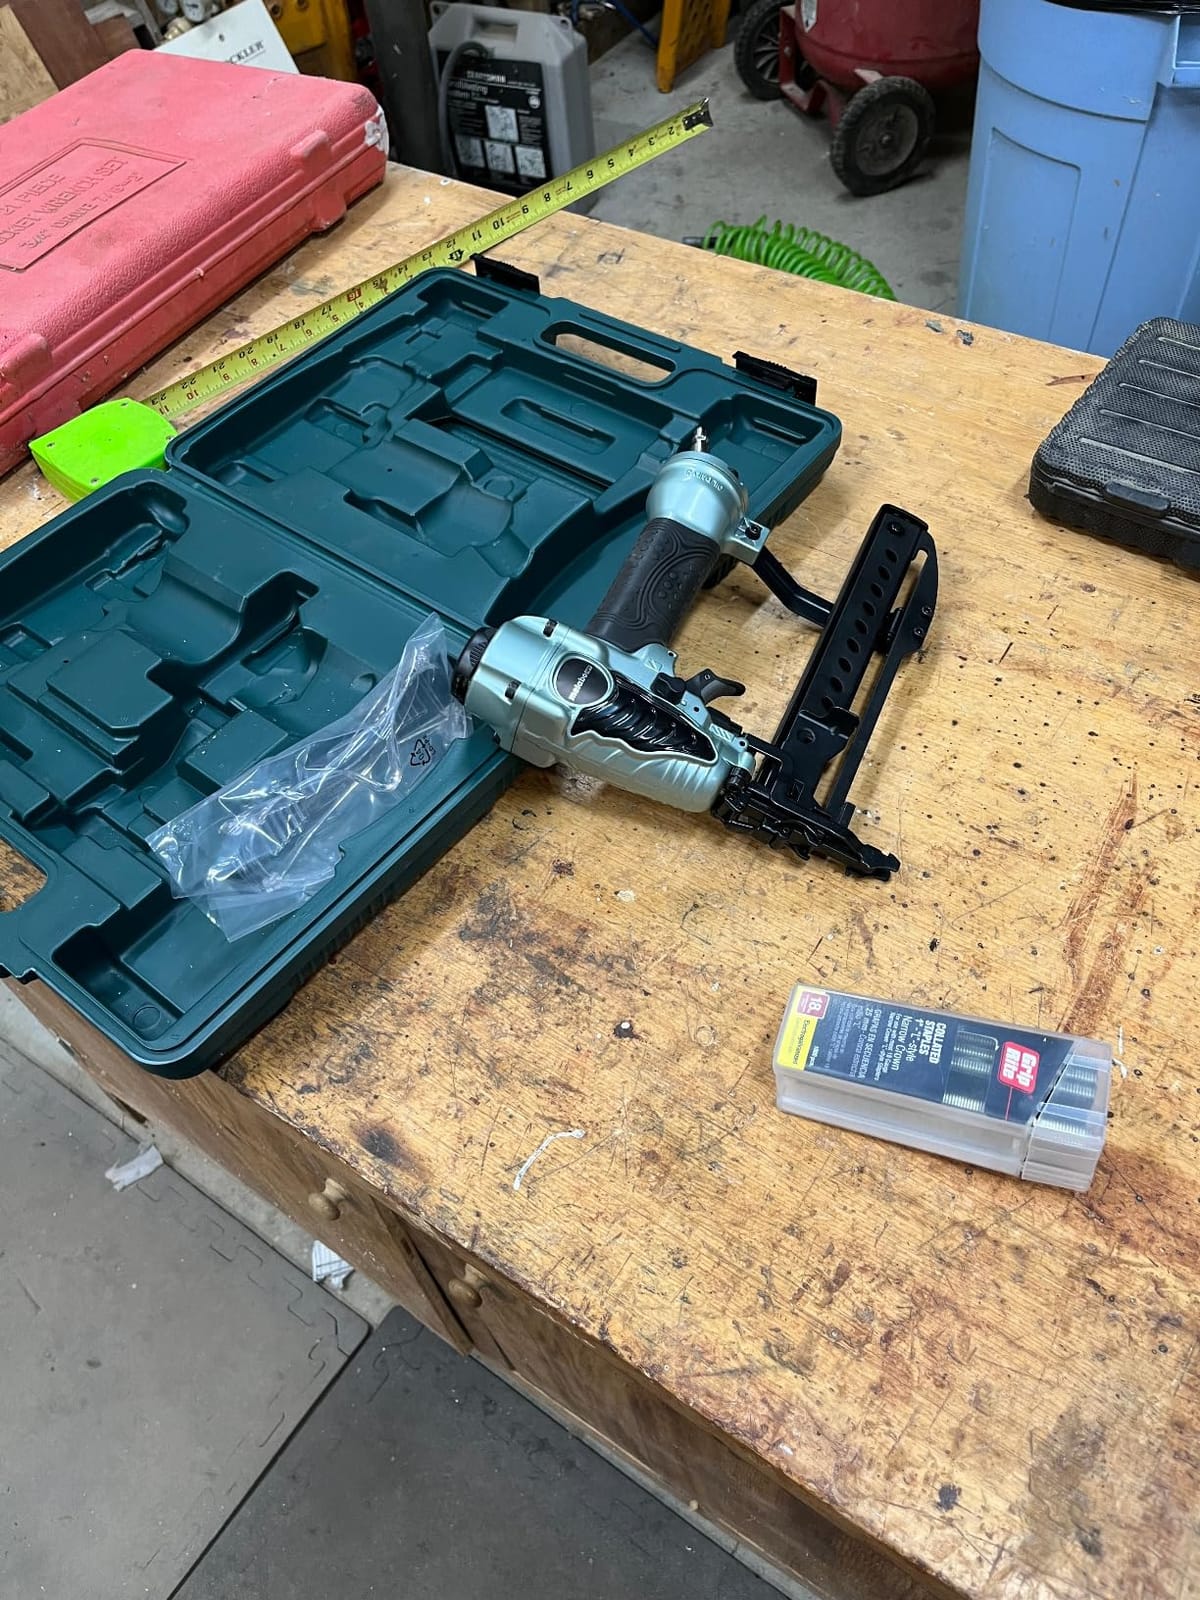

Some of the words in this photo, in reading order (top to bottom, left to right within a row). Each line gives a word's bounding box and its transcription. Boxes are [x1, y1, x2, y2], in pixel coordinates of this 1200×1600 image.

[648, 136, 655, 146] 3
[93, 156, 128, 177] SET
[608, 158, 615, 168] 5
[586, 170, 593, 179] 6
[566, 181, 573, 191] 7
[544, 192, 551, 202] 8
[522, 204, 529, 214] 9
[492, 217, 505, 230] 10
[471, 230, 482, 241] 11
[446, 238, 456, 248] 12
[422, 251, 433, 261] 13
[398, 264, 408, 274] 14
[348, 289, 361, 301] 16
[321, 305, 332, 316] 17
[332, 314, 339, 322] 5
[294, 320, 306, 330] 18
[305, 328, 313, 337] 6
[266, 333, 279, 344] 19
[238, 346, 254, 359] 20
[279, 343, 287, 351] 7
[212, 362, 226, 373] 21
[251, 358, 258, 366] 8
[223, 373, 230, 381] 9
[181, 378, 197, 389] 22
[151, 392, 167, 405] 23
[186, 389, 199, 400] 10
[159, 405, 170, 415] 11
[864, 1007, 873, 1016] 25
[868, 1009, 881, 1033] GRAPAS
[897, 1015, 912, 1043] Narrow
[866, 1033, 876, 1042] EN
[919, 1020, 935, 1055] STAPLES
[929, 1022, 946, 1064] COLLATED
[856, 1043, 873, 1079] SECUENCIA
[890, 1043, 905, 1071] Crown
[1002, 1047, 1021, 1079] Rite
[1016, 1052, 1037, 1087] Grip
